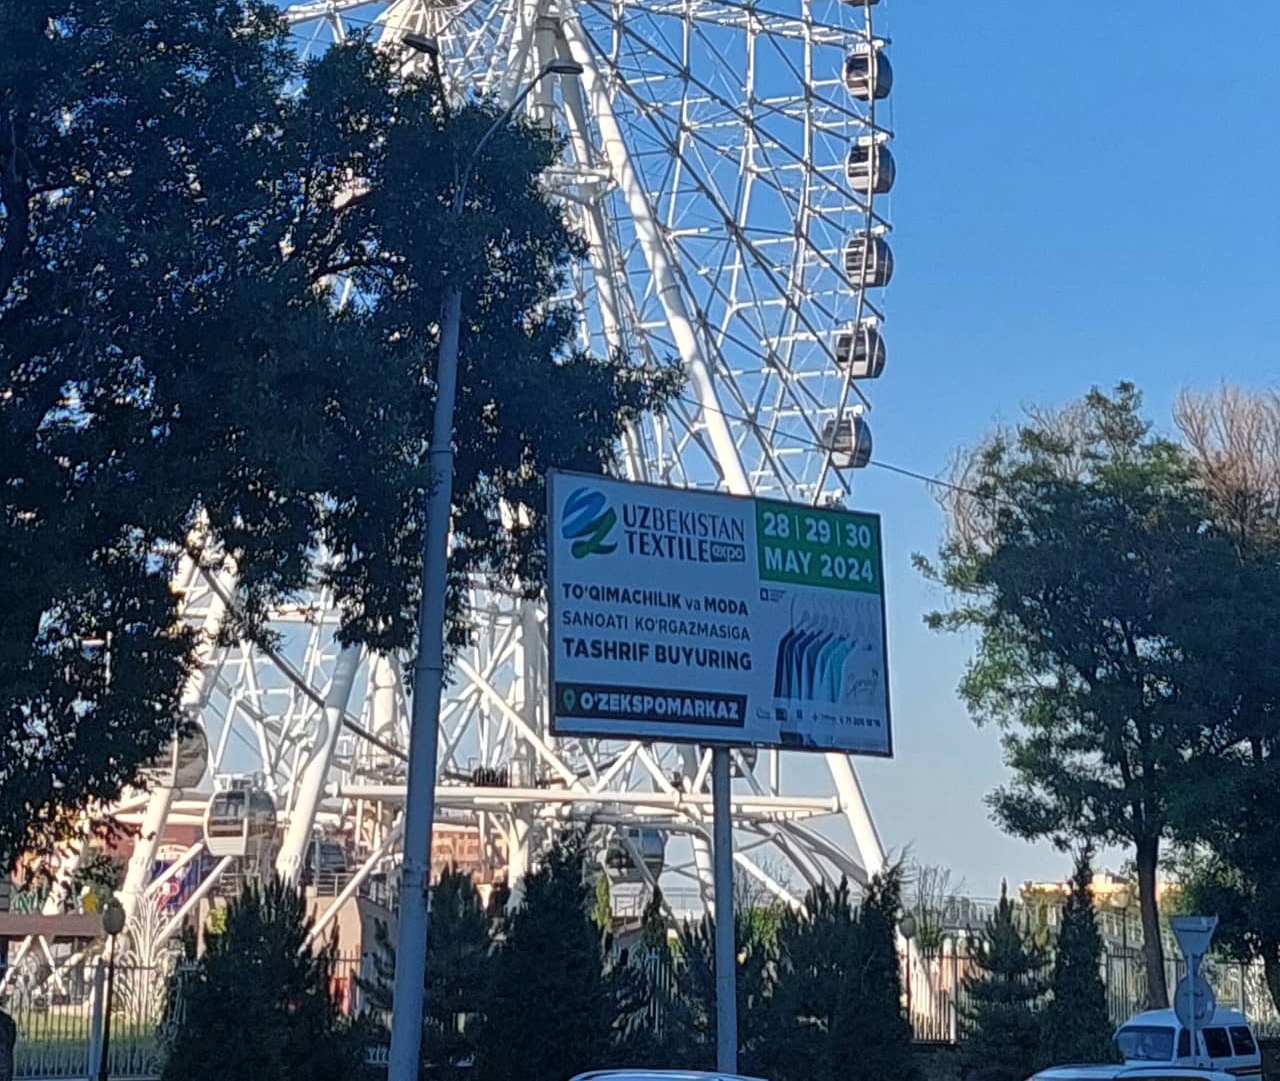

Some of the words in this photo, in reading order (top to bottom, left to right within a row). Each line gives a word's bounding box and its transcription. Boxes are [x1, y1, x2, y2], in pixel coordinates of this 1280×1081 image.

[623, 503, 745, 541] UZBEKISTAN
[763, 511, 790, 538] 28
[805, 518, 831, 544] 29
[846, 523, 871, 549] 30
[624, 530, 709, 562] TEXTILE
[712, 544, 744, 560] expo
[764, 546, 812, 575] MAY
[820, 554, 873, 583] 2024
[562, 610, 628, 630] SANOATI
[685, 599, 701, 610] va
[704, 596, 748, 616] MODA
[562, 637, 649, 662] TASHRIF
[655, 644, 752, 670] BUYURING
